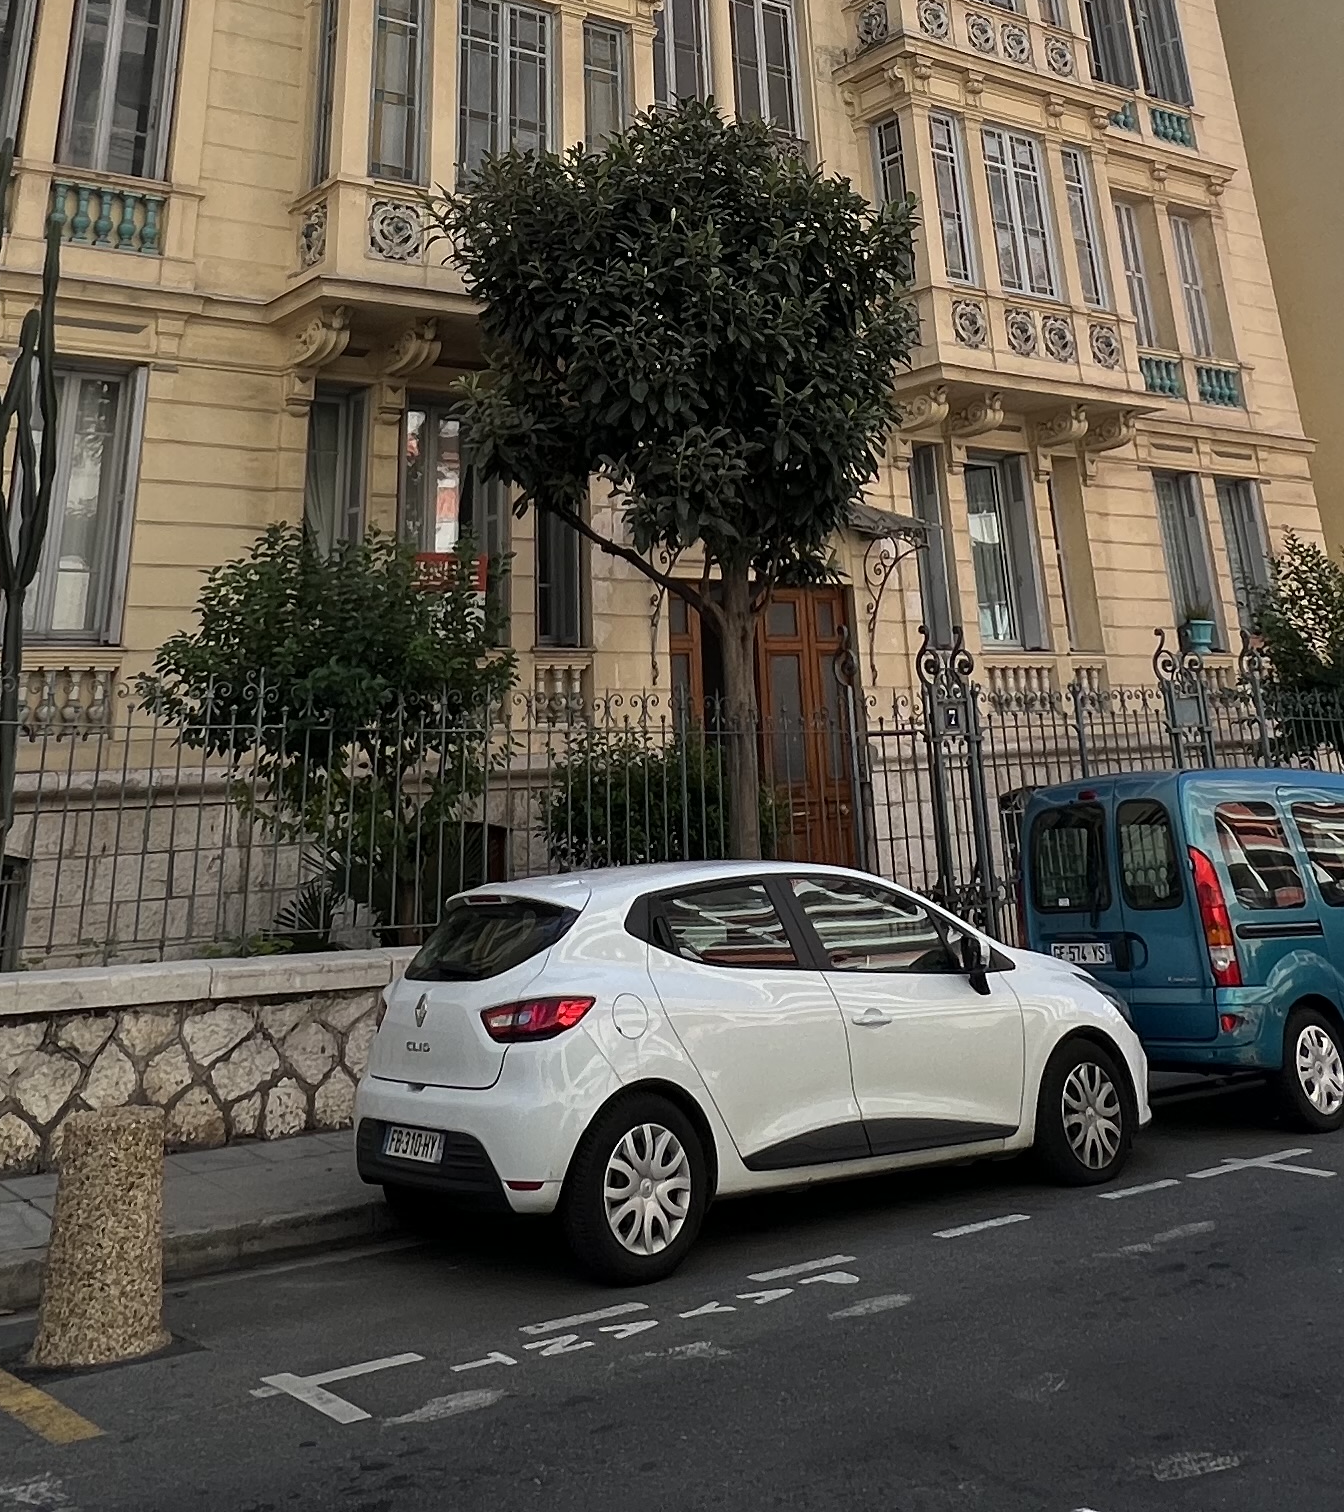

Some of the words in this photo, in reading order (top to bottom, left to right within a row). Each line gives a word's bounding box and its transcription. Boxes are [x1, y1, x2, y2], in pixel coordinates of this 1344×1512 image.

[948, 709, 956, 725] 7
[406, 1041, 431, 1052] CLIO
[449, 1270, 860, 1372] PAYANT
